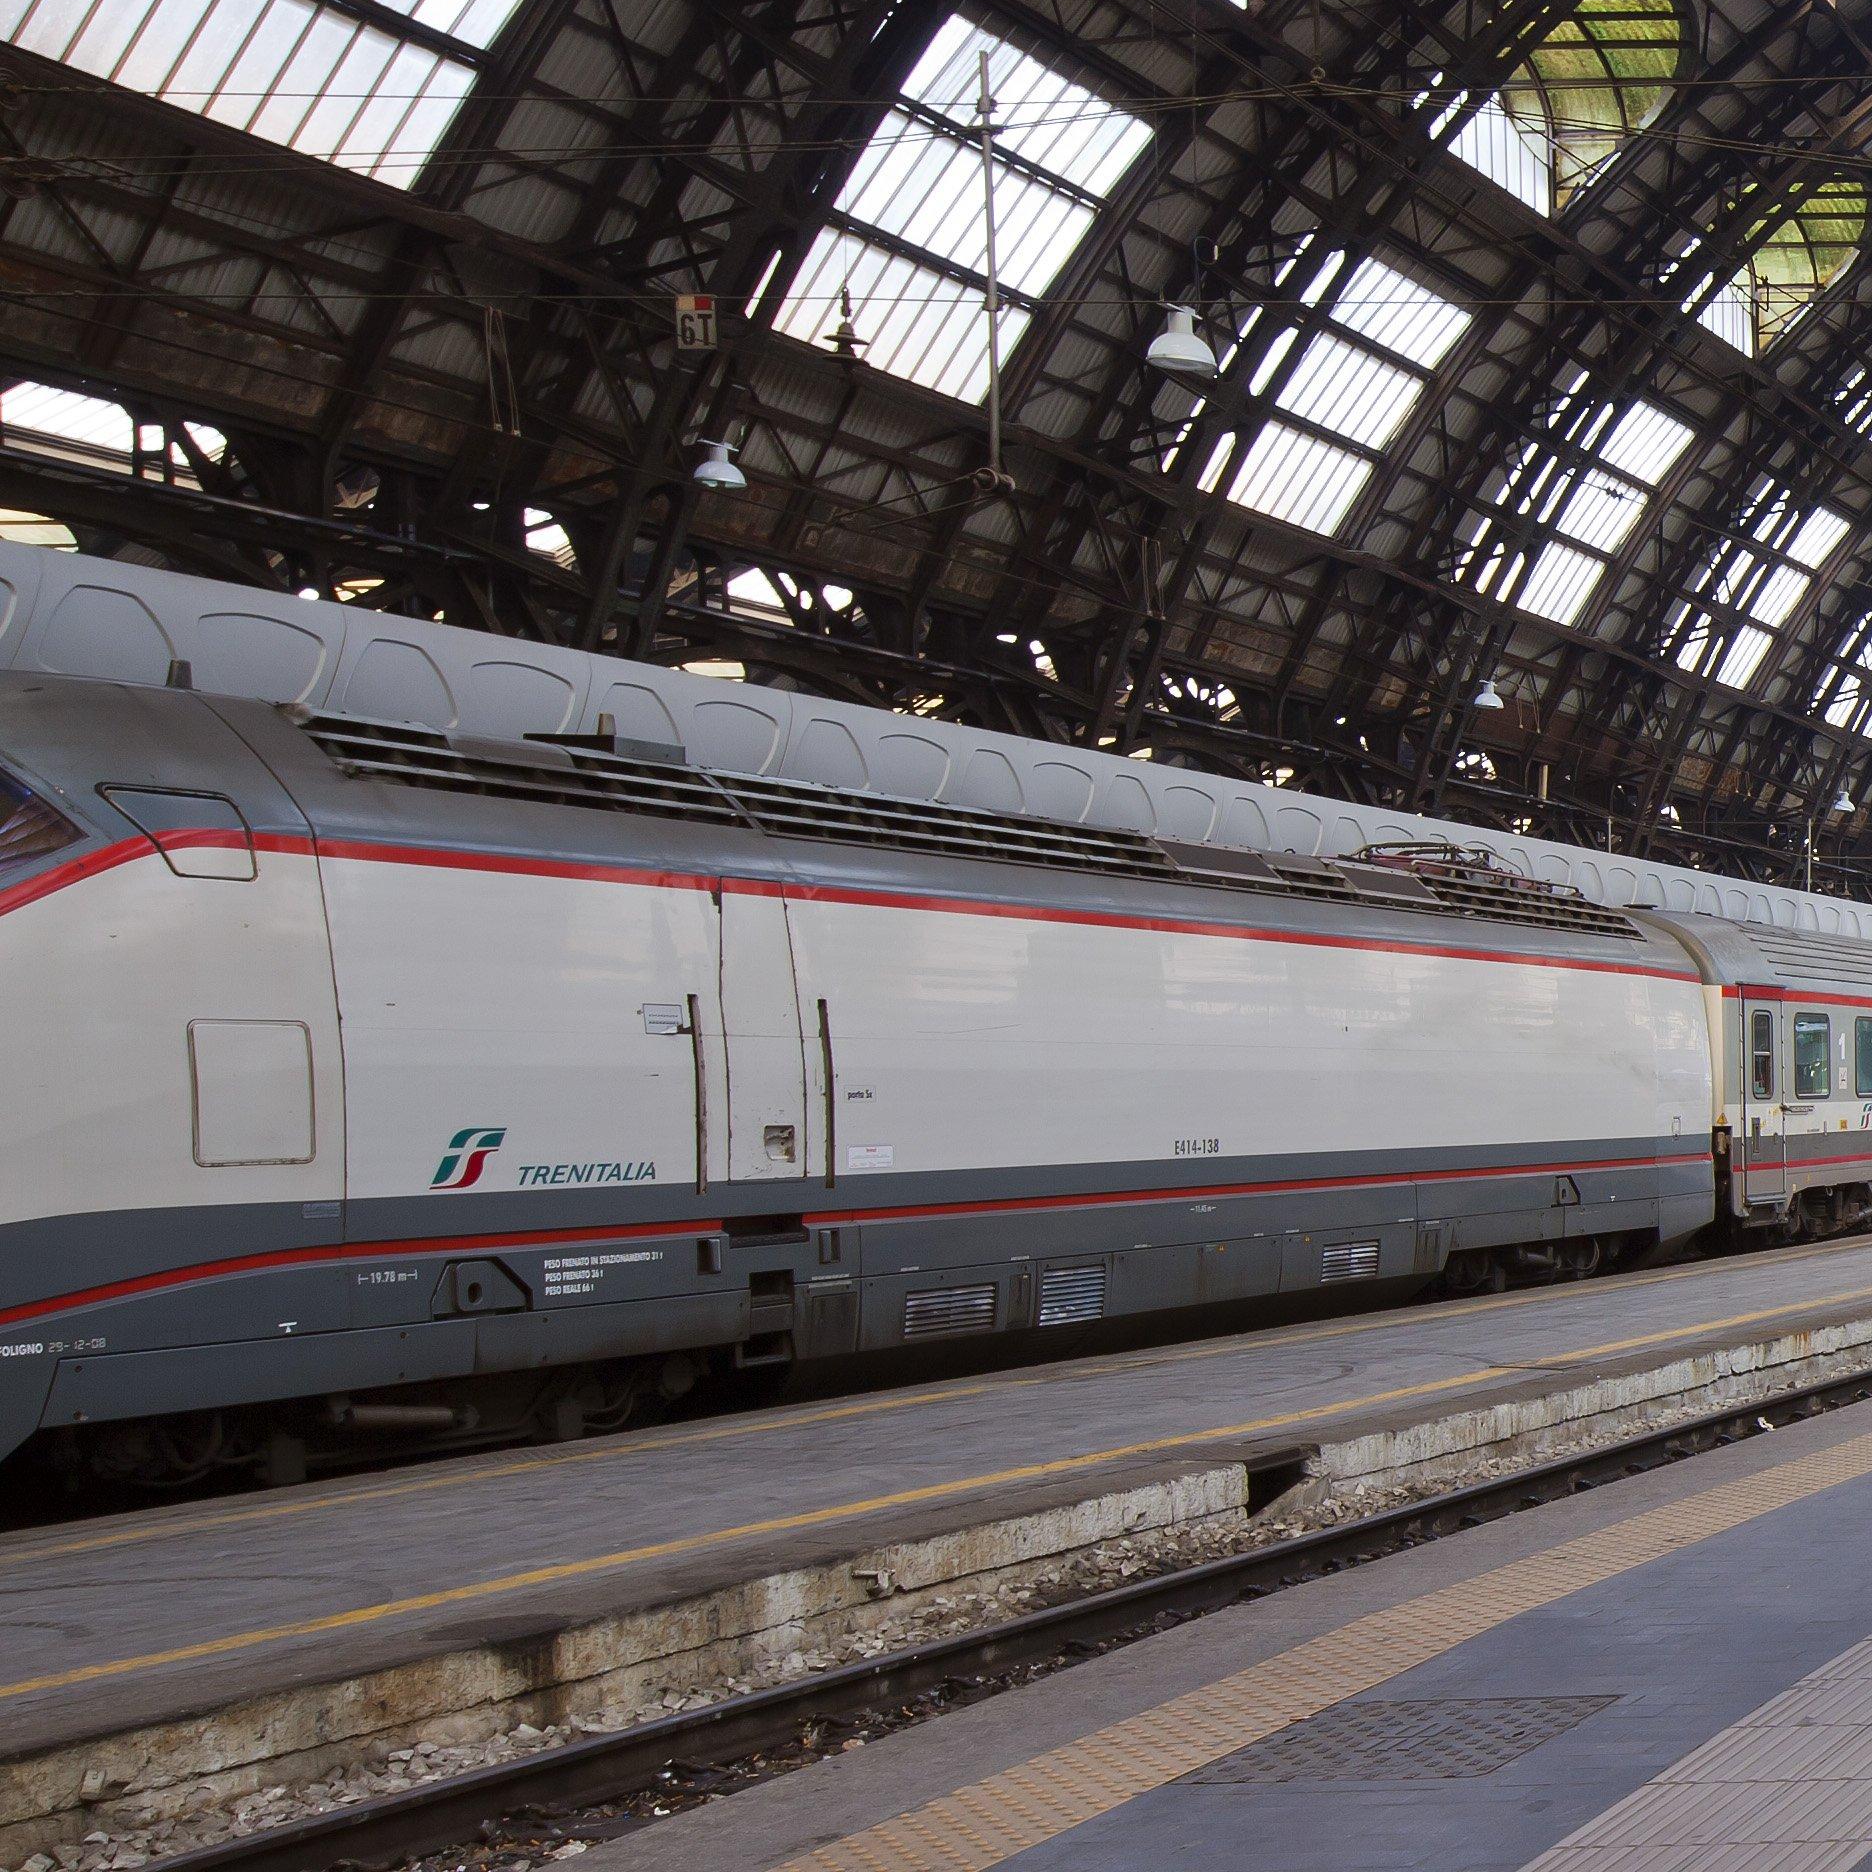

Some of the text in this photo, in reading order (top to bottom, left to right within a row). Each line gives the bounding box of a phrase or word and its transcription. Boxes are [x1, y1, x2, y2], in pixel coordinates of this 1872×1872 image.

[680, 313, 713, 346] 6T
[1838, 1032, 1846, 1060] 1
[1174, 1138, 1220, 1155] E414-138
[517, 1160, 657, 1187] TRENITALIA
[370, 1270, 396, 1284] 19.78
